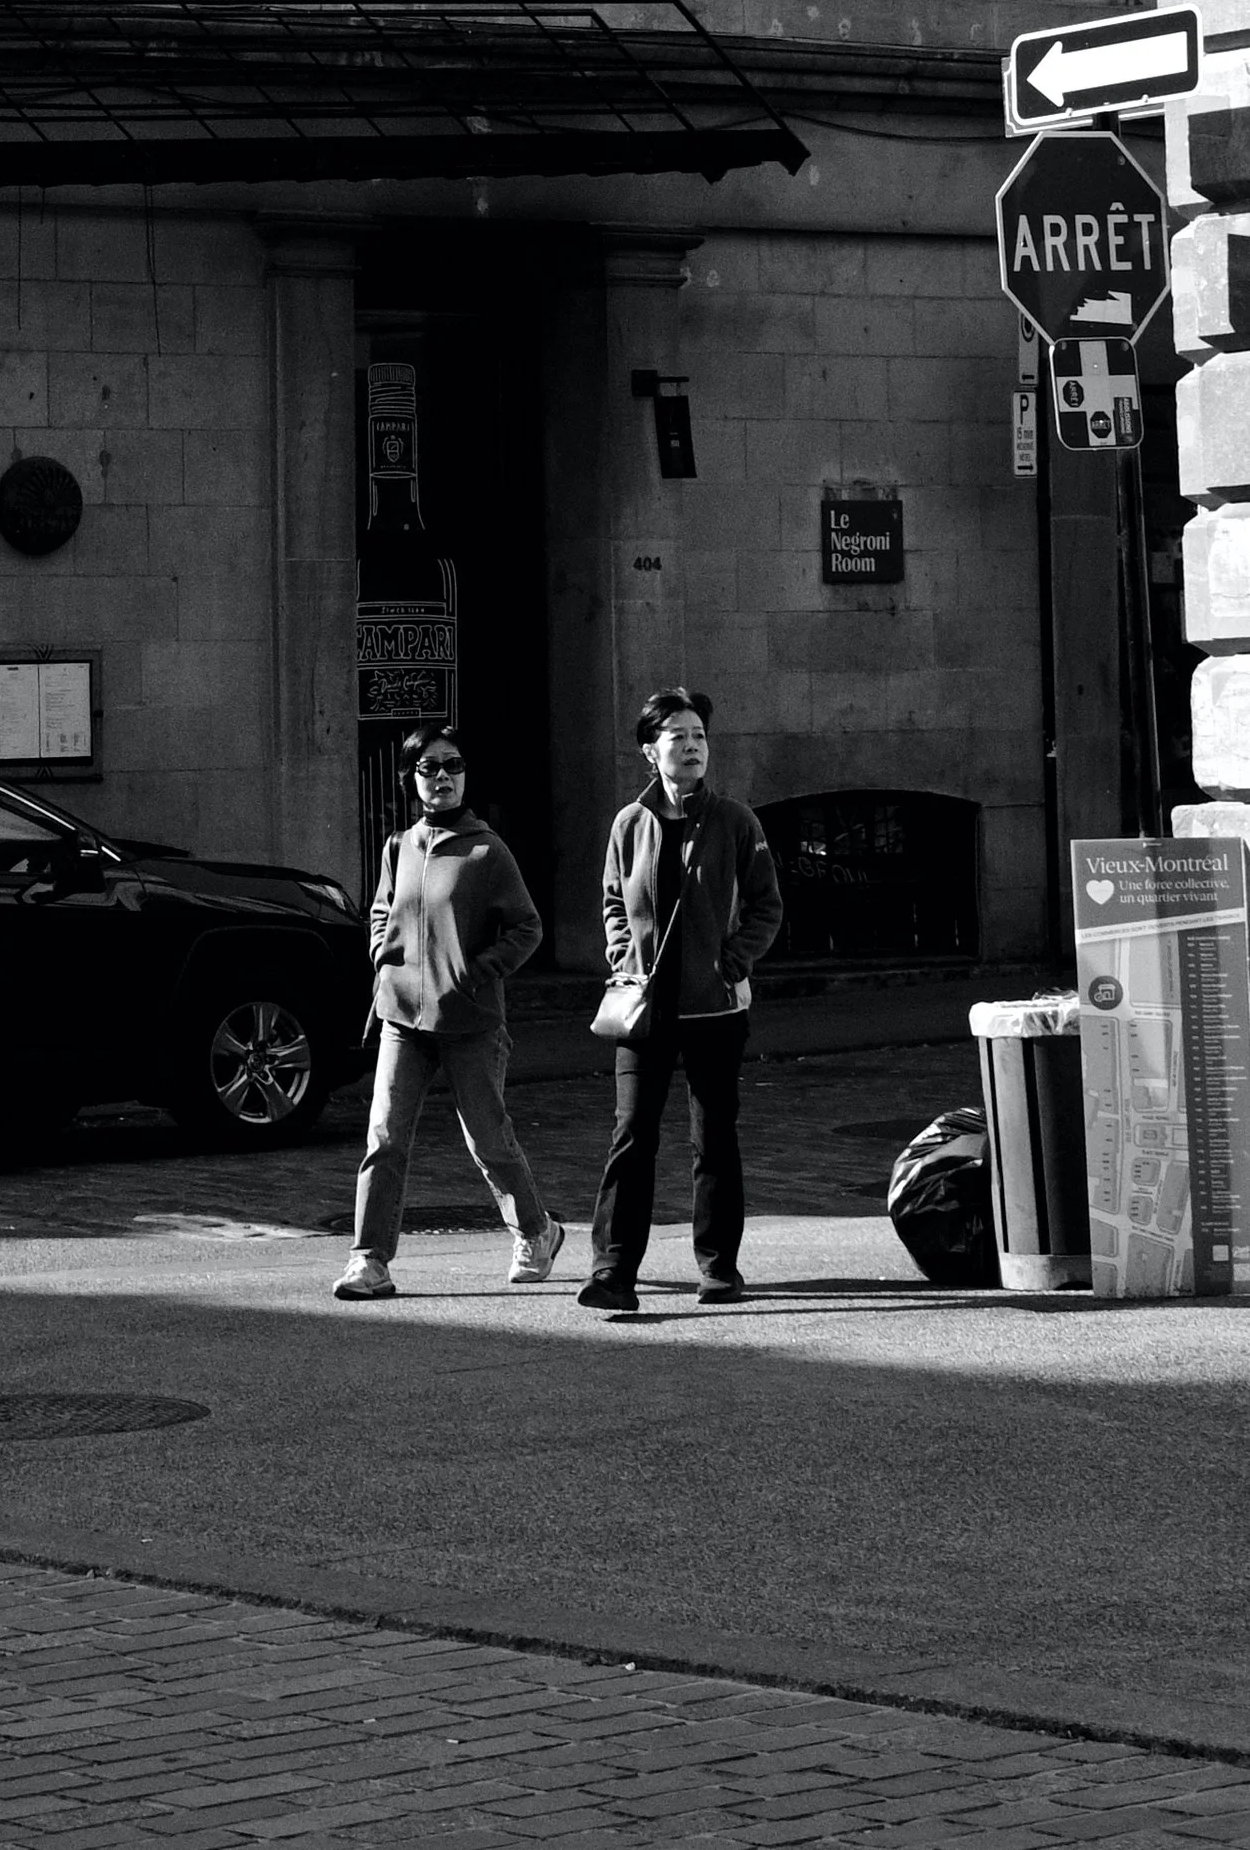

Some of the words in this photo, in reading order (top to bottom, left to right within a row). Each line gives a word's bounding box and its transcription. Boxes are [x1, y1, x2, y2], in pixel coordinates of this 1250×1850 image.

[1013, 201, 1156, 272] ARRÊT
[1020, 394, 1029, 425] P
[830, 509, 850, 529] Le
[830, 531, 891, 556] Negroni
[633, 556, 662, 571] 404
[831, 552, 876, 573] Room
[356, 624, 455, 662] AMPARI
[1085, 853, 1229, 874] Vieux-Montréal
[1119, 880, 1143, 891] Une
[1145, 878, 1173, 890] force
[1119, 895, 1134, 904] un
[1136, 893, 1181, 906] quartier
[1183, 891, 1219, 903] vivant
